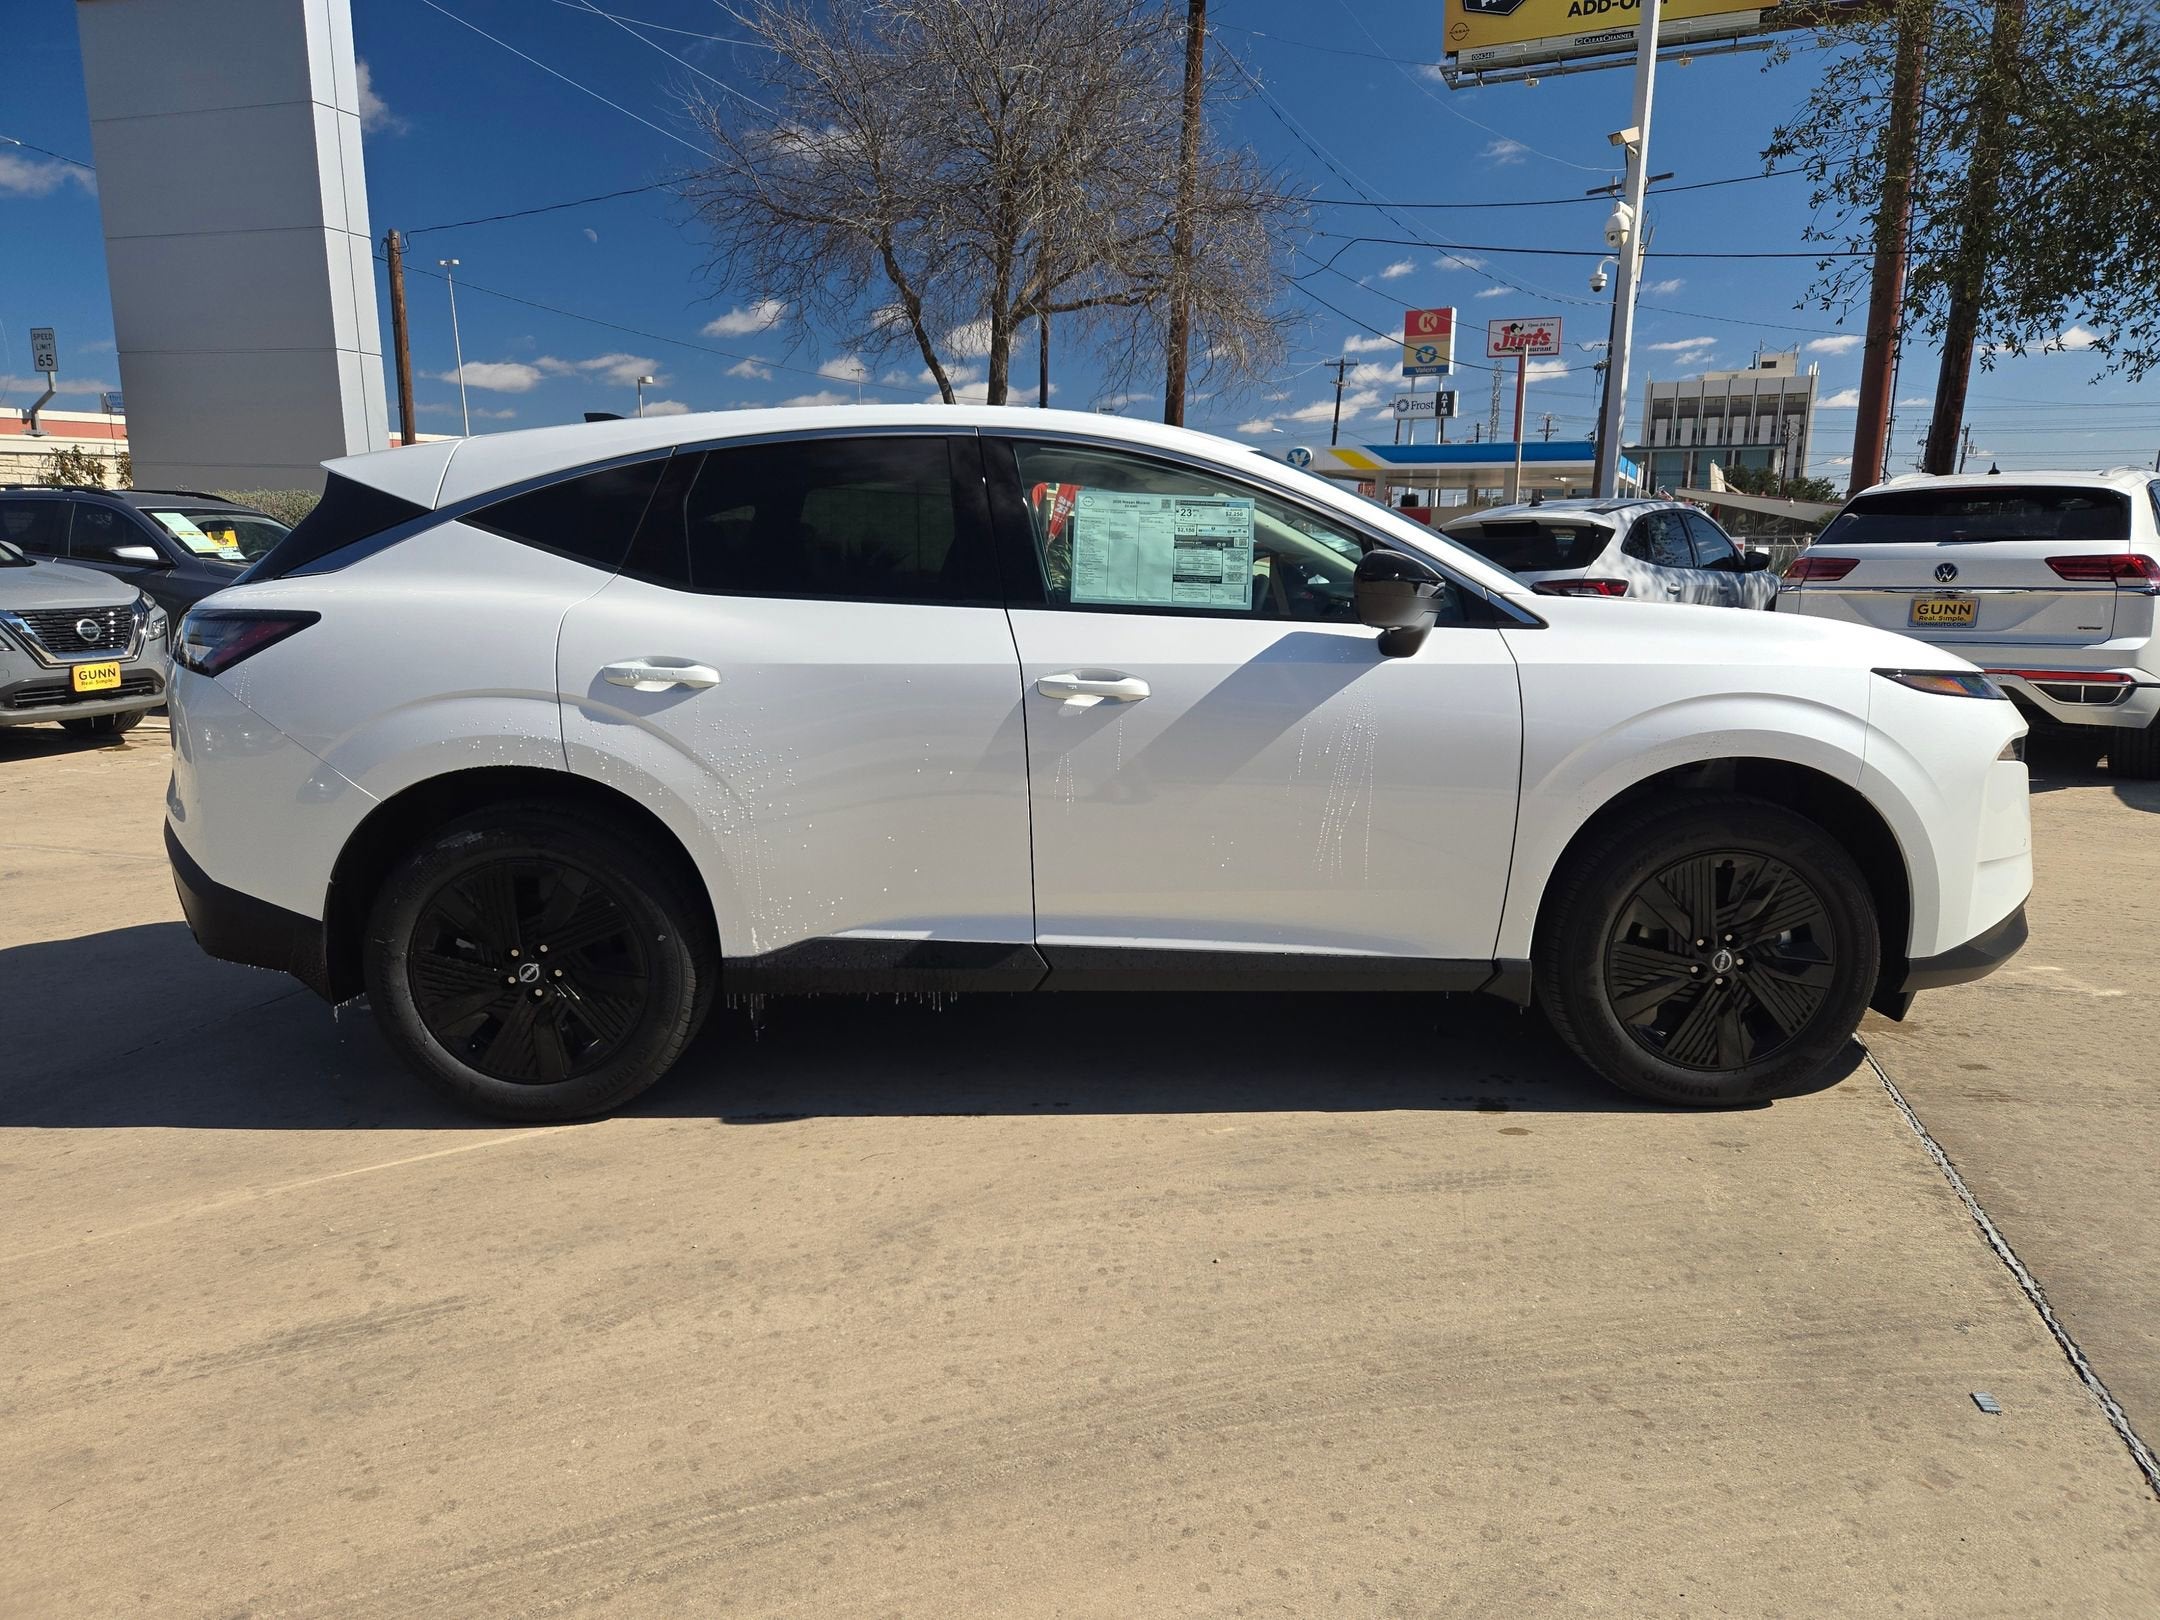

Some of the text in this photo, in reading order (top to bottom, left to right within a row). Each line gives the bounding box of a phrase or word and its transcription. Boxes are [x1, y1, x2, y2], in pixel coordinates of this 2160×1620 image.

[33, 333, 53, 341] SPEED
[1494, 326, 1551, 351] Jim's
[36, 343, 51, 351] LIMIT
[38, 354, 54, 367] 65
[1411, 400, 1435, 410] Frost
[1440, 393, 1449, 415] ATM
[1180, 508, 1192, 517] 23
[1917, 604, 1971, 615] GUNN
[79, 668, 115, 680] GUNN
